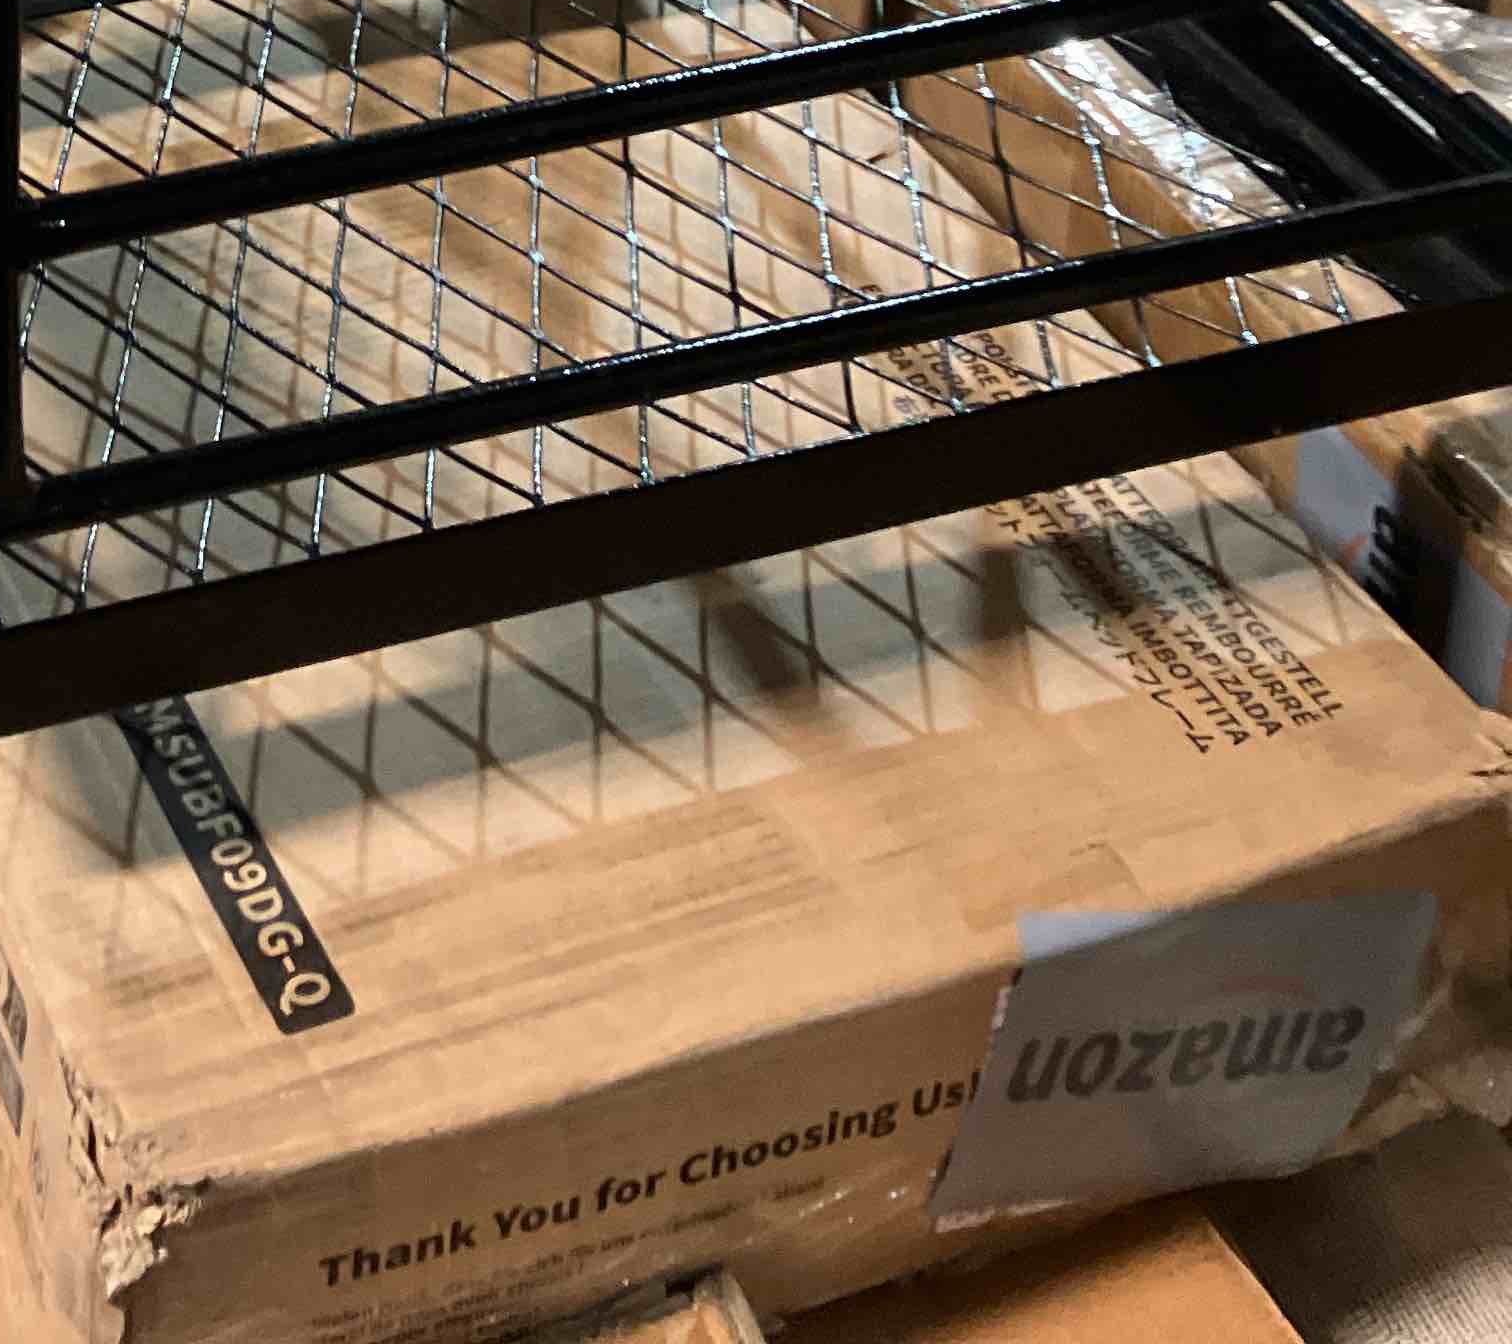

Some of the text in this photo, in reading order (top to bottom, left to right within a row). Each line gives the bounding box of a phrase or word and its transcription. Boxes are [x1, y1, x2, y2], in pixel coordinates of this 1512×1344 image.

[1130, 621, 1251, 747] IMBOTTITA
[1172, 582, 1324, 728] REMBOURRÉ
[1174, 624, 1283, 739] TAPIZADA
[1006, 1003, 1366, 1104] amazon
[318, 1220, 478, 1288] Thank
[494, 1193, 581, 1241] You
[594, 1167, 667, 1214] for
[679, 1100, 899, 1186] Choosing
[912, 1068, 981, 1118] Us!
